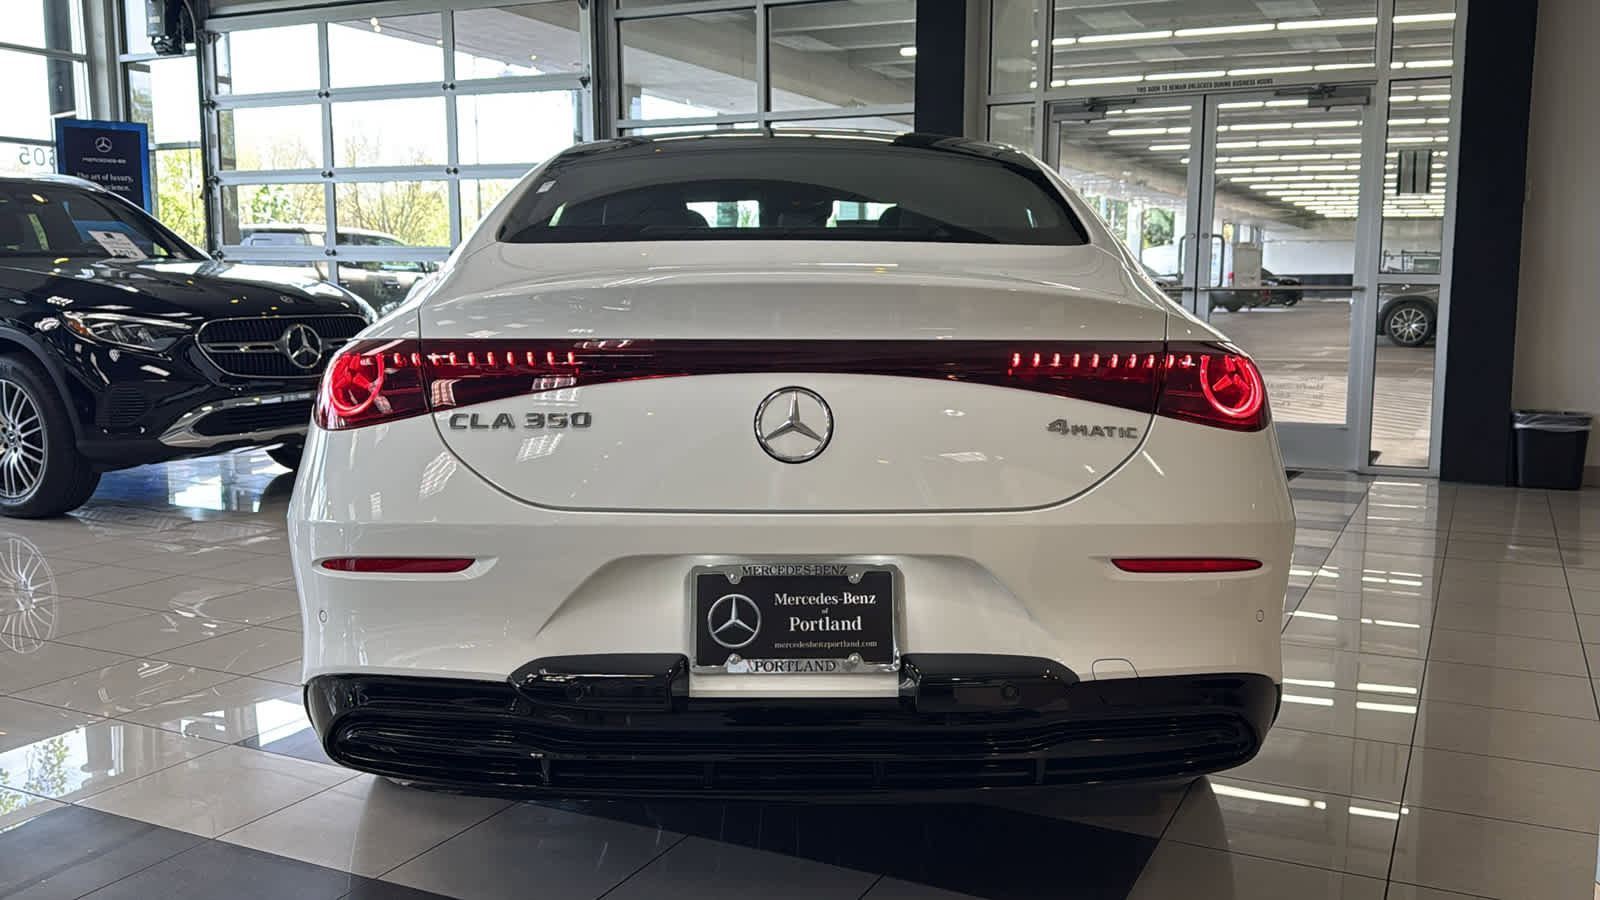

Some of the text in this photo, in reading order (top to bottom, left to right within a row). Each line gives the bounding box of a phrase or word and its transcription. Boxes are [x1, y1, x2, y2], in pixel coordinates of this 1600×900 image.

[101, 173, 109, 181] of
[450, 411, 592, 430] CLA 350
[1047, 418, 1138, 440] 4MATIC
[774, 592, 877, 606] Mercedes-Benz
[789, 616, 863, 632] Portland
[774, 640, 878, 650] mercedesbenzportland.com
[754, 660, 837, 673] PORTLAND
